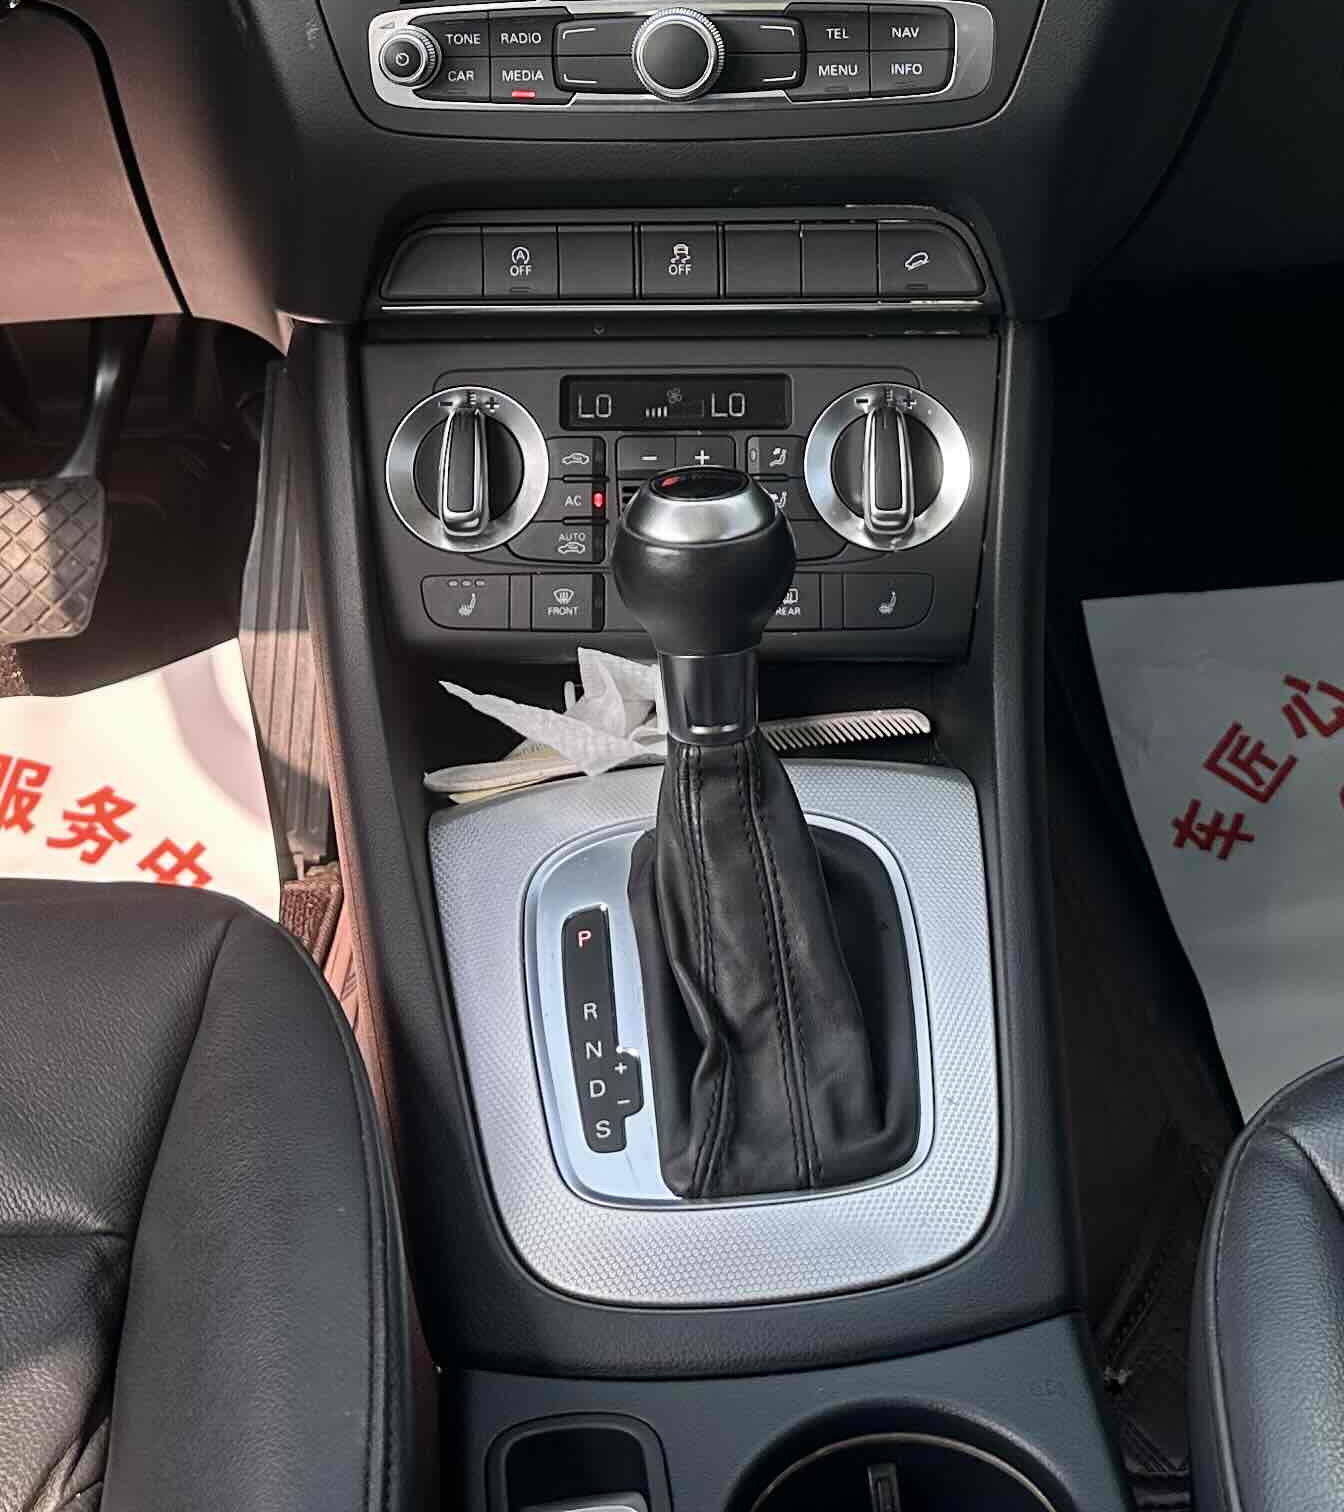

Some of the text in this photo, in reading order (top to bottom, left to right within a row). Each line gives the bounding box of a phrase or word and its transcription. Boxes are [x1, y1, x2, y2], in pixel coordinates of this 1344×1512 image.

[446, 32, 481, 46] TONE
[500, 32, 543, 45] RADIO
[825, 27, 849, 40] TEL
[891, 26, 920, 39] NAV
[447, 69, 475, 82] CAR
[501, 69, 545, 83] MEDIA
[818, 63, 859, 77] MENU
[890, 63, 923, 76] INFO
[509, 264, 532, 277] OFF
[668, 263, 692, 276] OFF
[577, 393, 612, 419] LO
[711, 392, 746, 418] LO
[564, 495, 582, 507] AC
[558, 531, 586, 543] AUTO
[547, 606, 578, 617] FRONT
[775, 606, 801, 617] REAR
[577, 930, 593, 948] P
[583, 1003, 599, 1021] R
[585, 1041, 603, 1060] N
[589, 1079, 606, 1099] D
[595, 1120, 611, 1139] S
